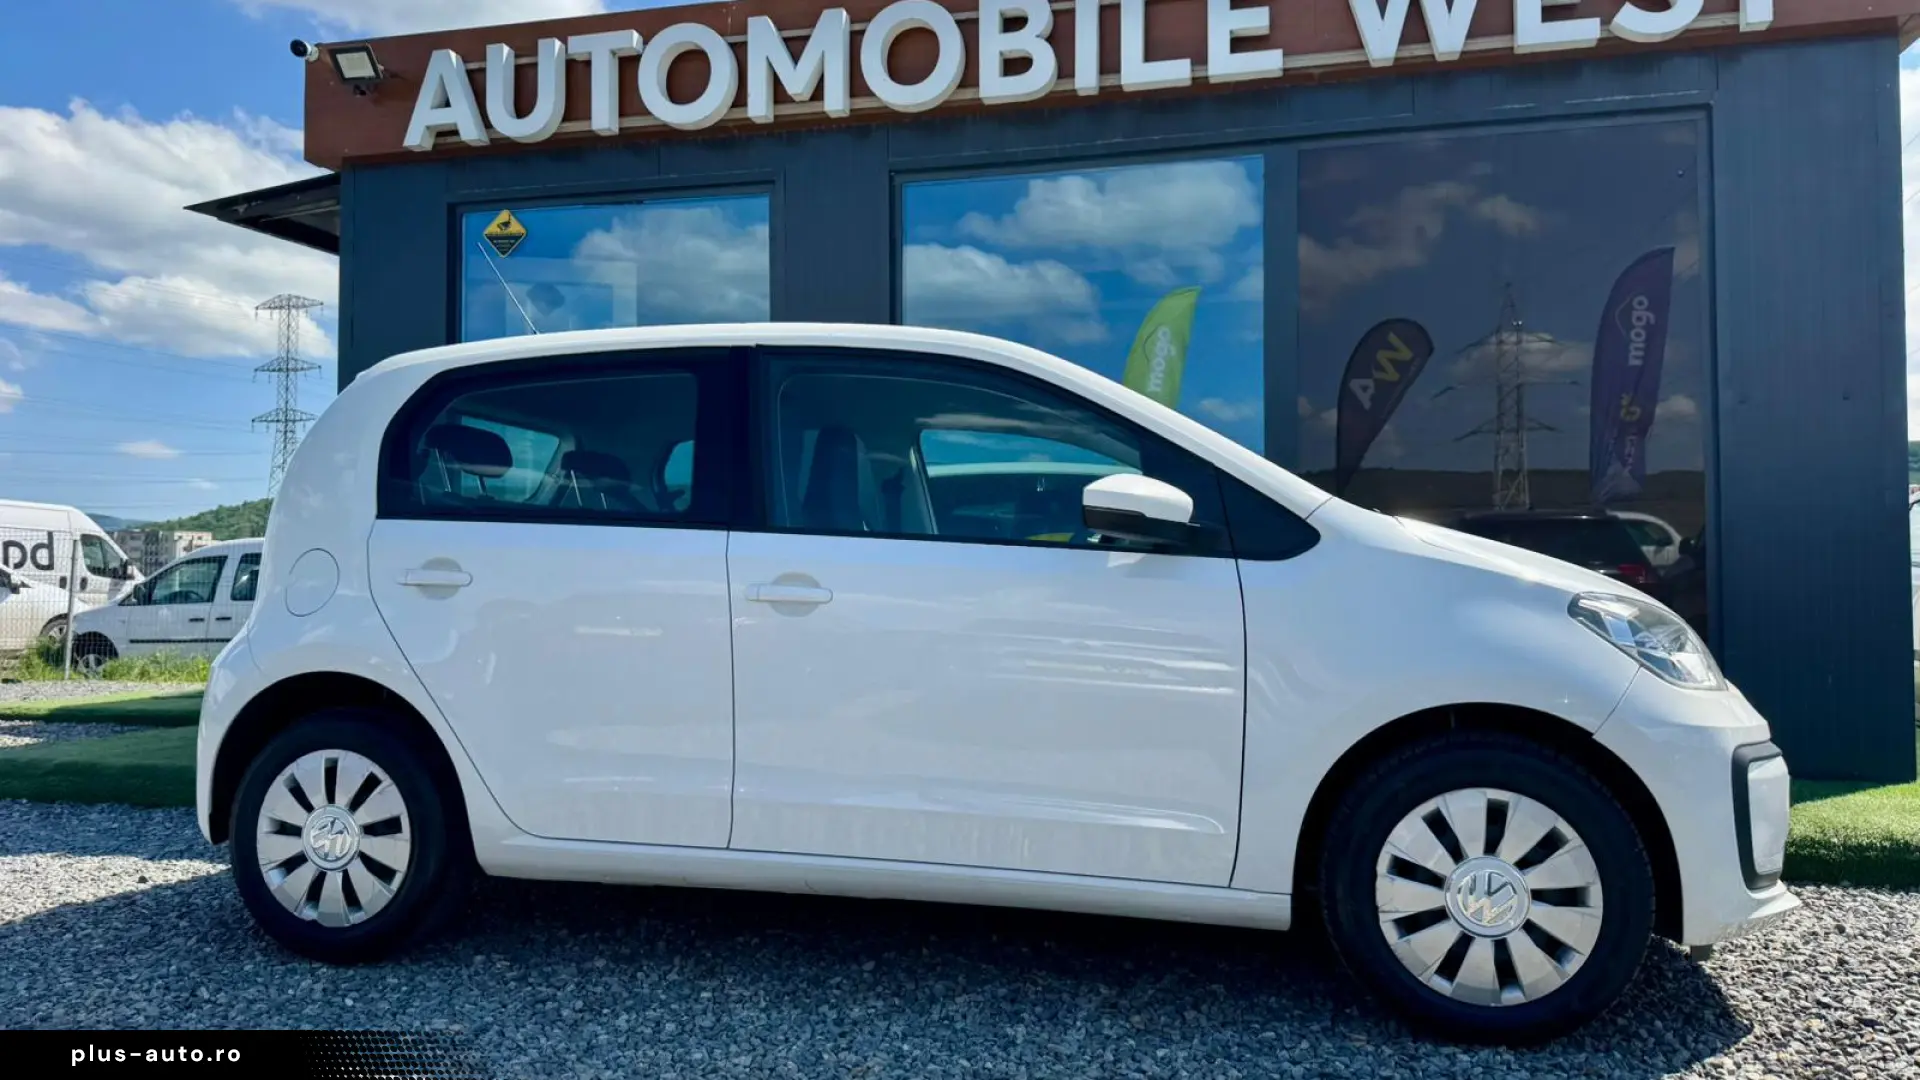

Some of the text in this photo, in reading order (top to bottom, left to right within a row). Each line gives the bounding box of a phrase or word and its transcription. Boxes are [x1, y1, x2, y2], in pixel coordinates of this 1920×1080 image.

[403, 0, 1283, 151] AUTOMOBILE
[1146, 326, 1176, 392] mogo
[1628, 295, 1656, 367] mogo
[1349, 331, 1414, 411] AW
